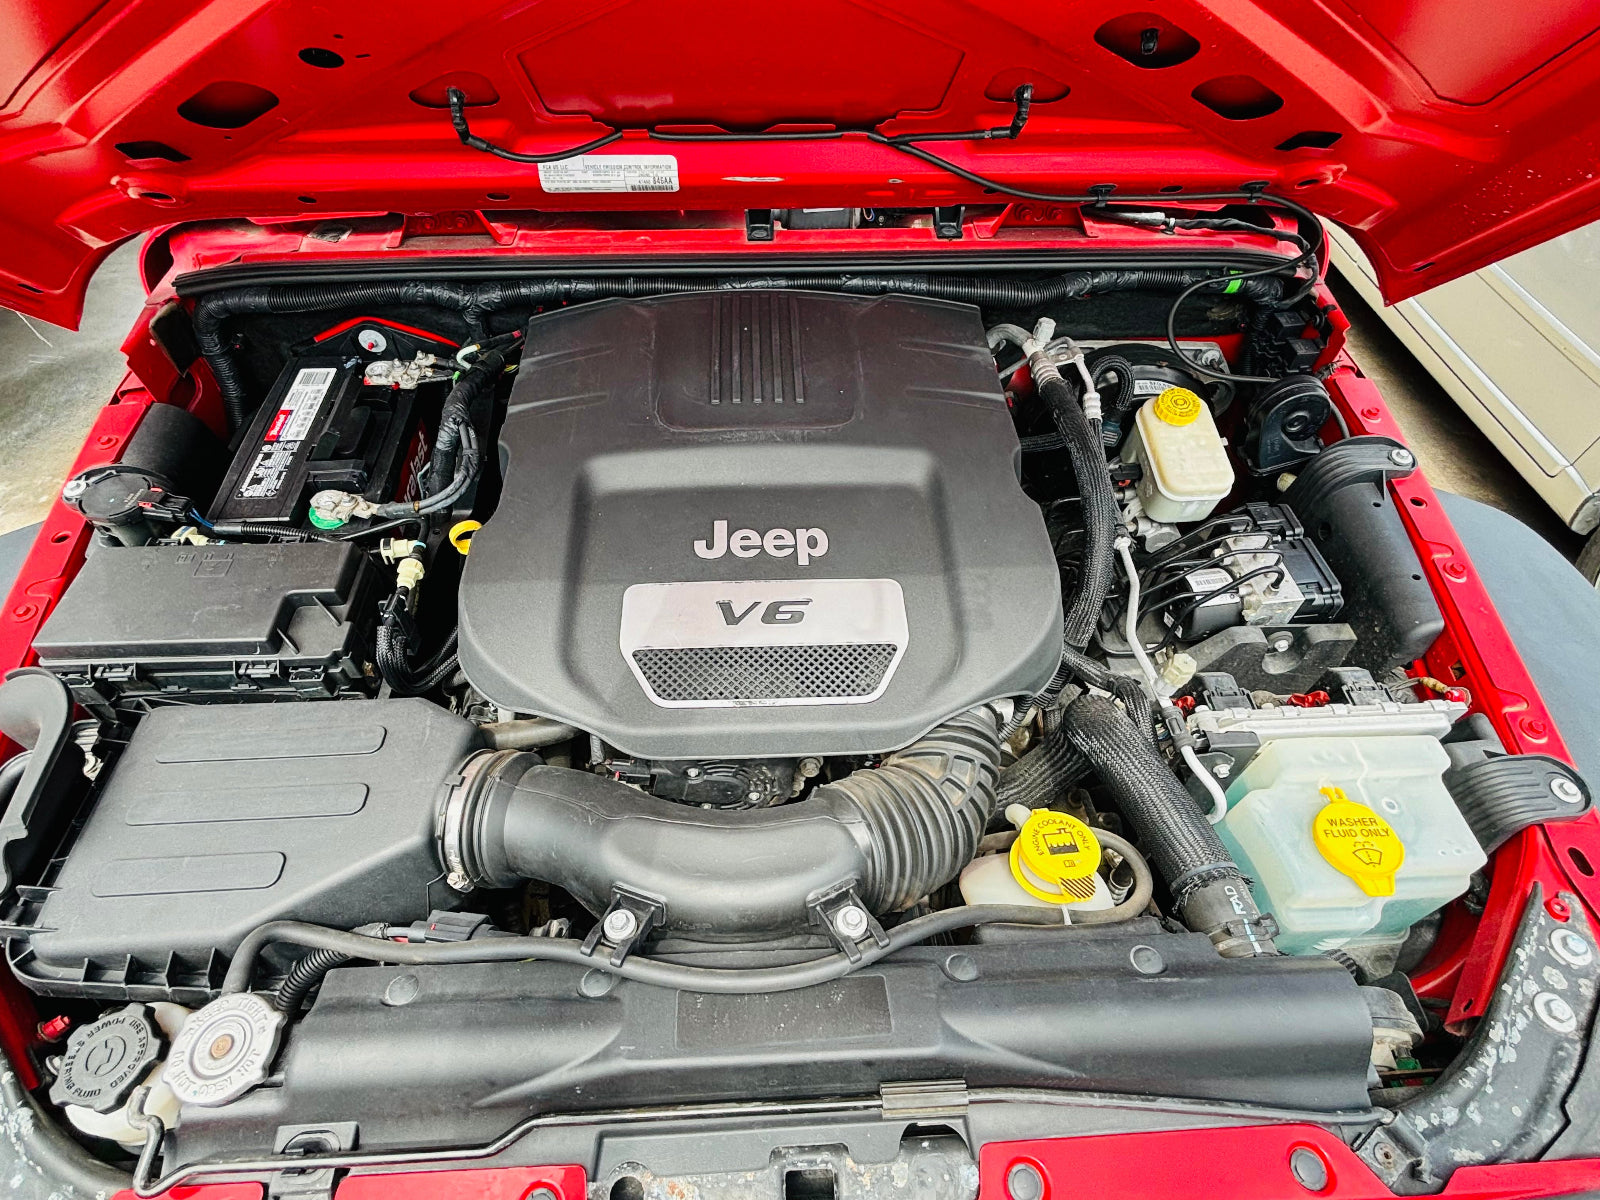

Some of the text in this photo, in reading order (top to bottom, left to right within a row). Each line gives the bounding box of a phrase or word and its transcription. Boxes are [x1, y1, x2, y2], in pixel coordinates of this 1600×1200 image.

[693, 519, 829, 566] Jeep
[716, 598, 813, 626] V6
[1032, 818, 1091, 856] ENGINE COOLANT ONLY
[1323, 828, 1391, 838] FLUID ONLY
[1326, 817, 1378, 827] WASHER
[1224, 885, 1247, 915] RAD
[239, 997, 268, 1024] TIGHT
[64, 1017, 126, 1099] POWER STEERING FLUID
[110, 1019, 146, 1089] USE APPROVED
